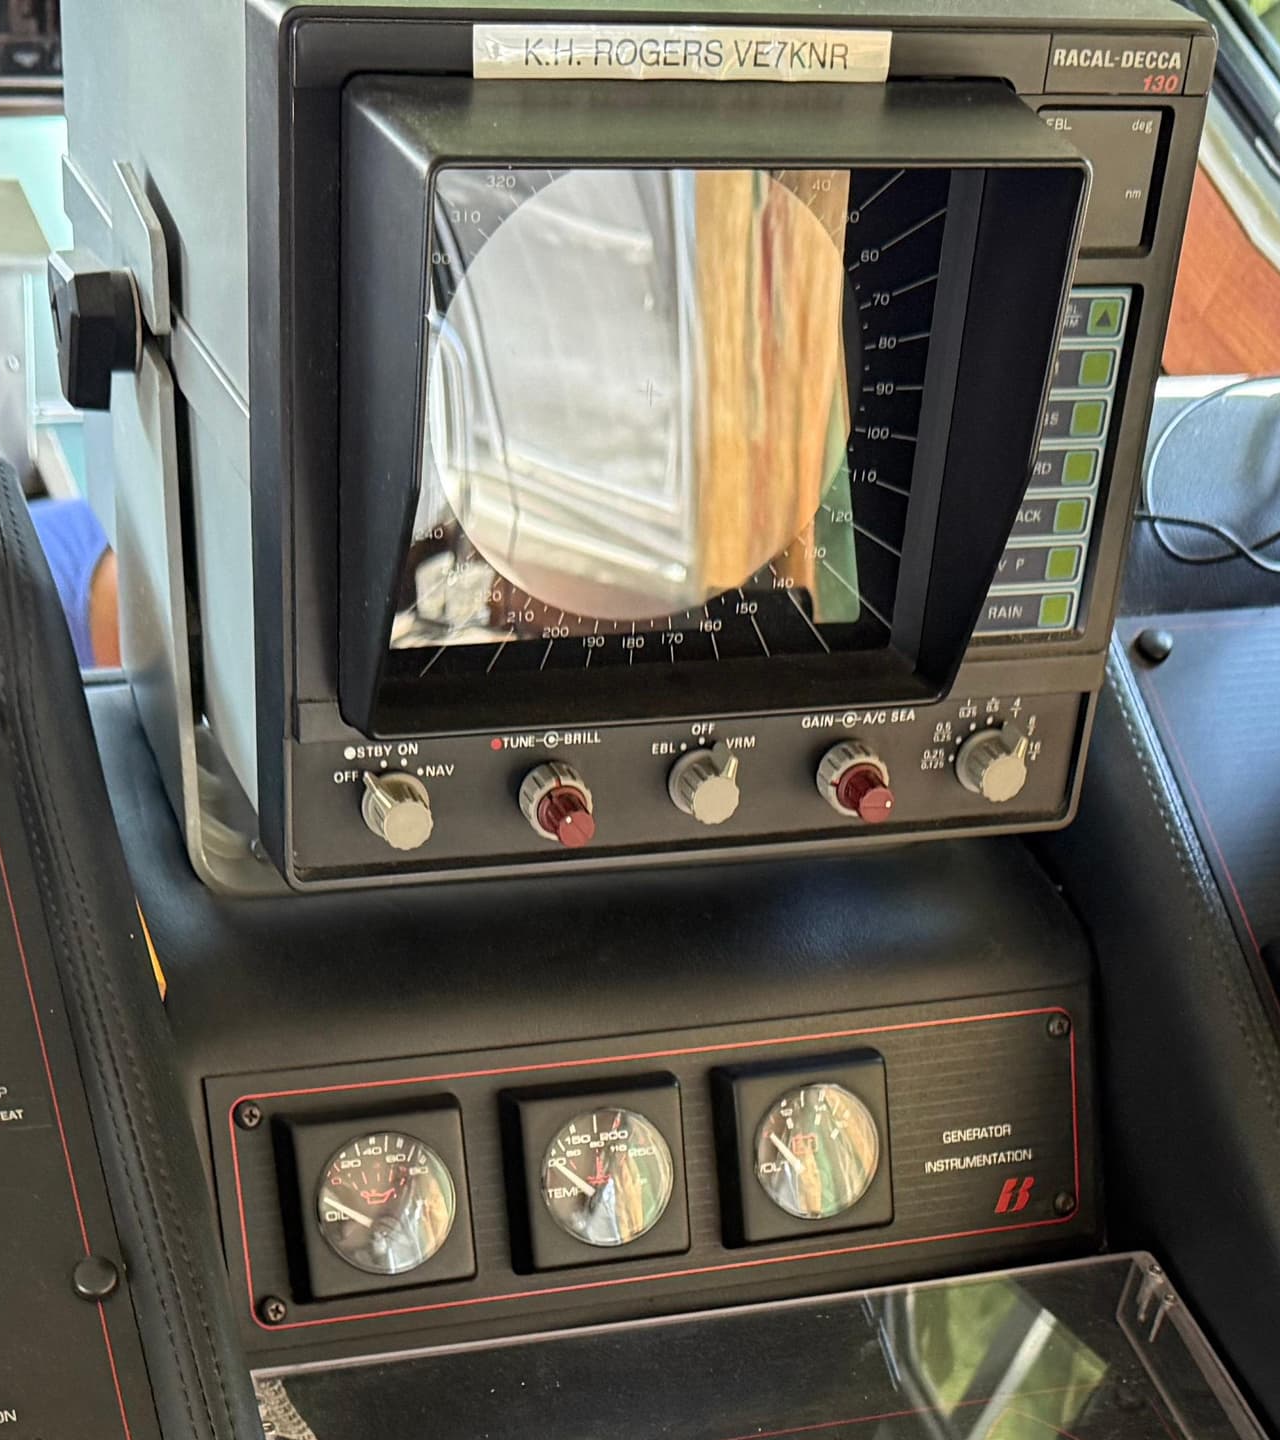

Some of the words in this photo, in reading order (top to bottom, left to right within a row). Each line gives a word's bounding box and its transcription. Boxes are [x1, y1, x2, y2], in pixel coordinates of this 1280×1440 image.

[524, 38, 582, 67] K.H.
[594, 39, 724, 68] ROGERS
[734, 40, 849, 70] VE7KNR
[1053, 48, 1182, 69] RACAL-DECCA
[1143, 74, 1179, 93] 130
[1132, 119, 1153, 134] deg
[1125, 189, 1141, 199] nm
[876, 383, 894, 395] 90
[988, 605, 1024, 620] RAIN
[802, 716, 834, 728] GAIN
[863, 712, 886, 724] A/C
[892, 710, 916, 722] SEA
[692, 723, 716, 735] OFF
[503, 736, 535, 749] TUNE
[565, 732, 601, 745] BRILL
[726, 737, 756, 749] VRM
[357, 744, 392, 758] STBY
[398, 743, 418, 756] ON
[652, 743, 675, 755] EBL
[334, 771, 358, 784] OFF
[426, 765, 454, 777] NAV
[943, 1124, 1011, 1144] GENERATOR
[925, 1149, 1033, 1174] INSTRUMENTATION
